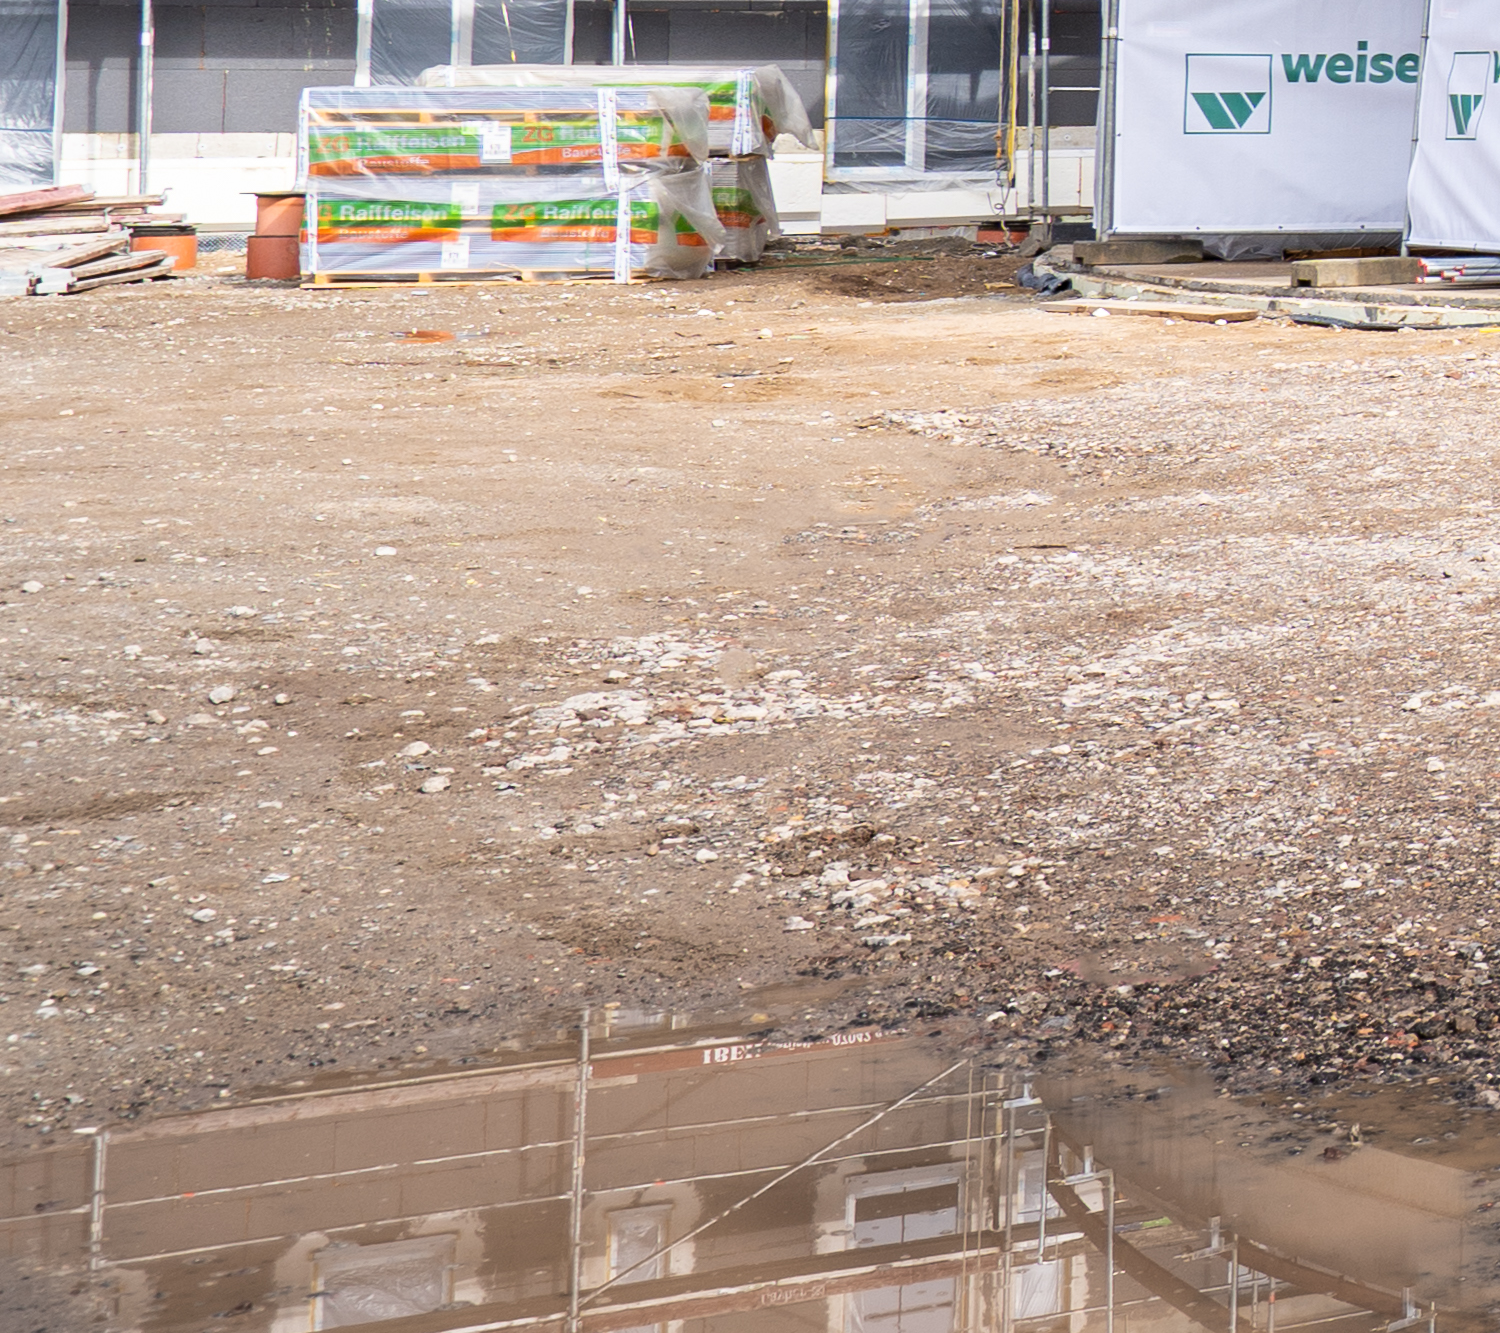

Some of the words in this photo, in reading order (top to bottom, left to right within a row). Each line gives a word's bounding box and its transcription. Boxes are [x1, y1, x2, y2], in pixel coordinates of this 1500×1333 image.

[523, 126, 555, 143] ZG
[316, 136, 349, 154] ZG
[357, 134, 466, 150] Raiffeisen
[339, 204, 448, 221] Raiffeisen
[504, 204, 536, 221] ZG
[338, 227, 409, 240] Baustoffe
[540, 226, 610, 239] Baustoffe
